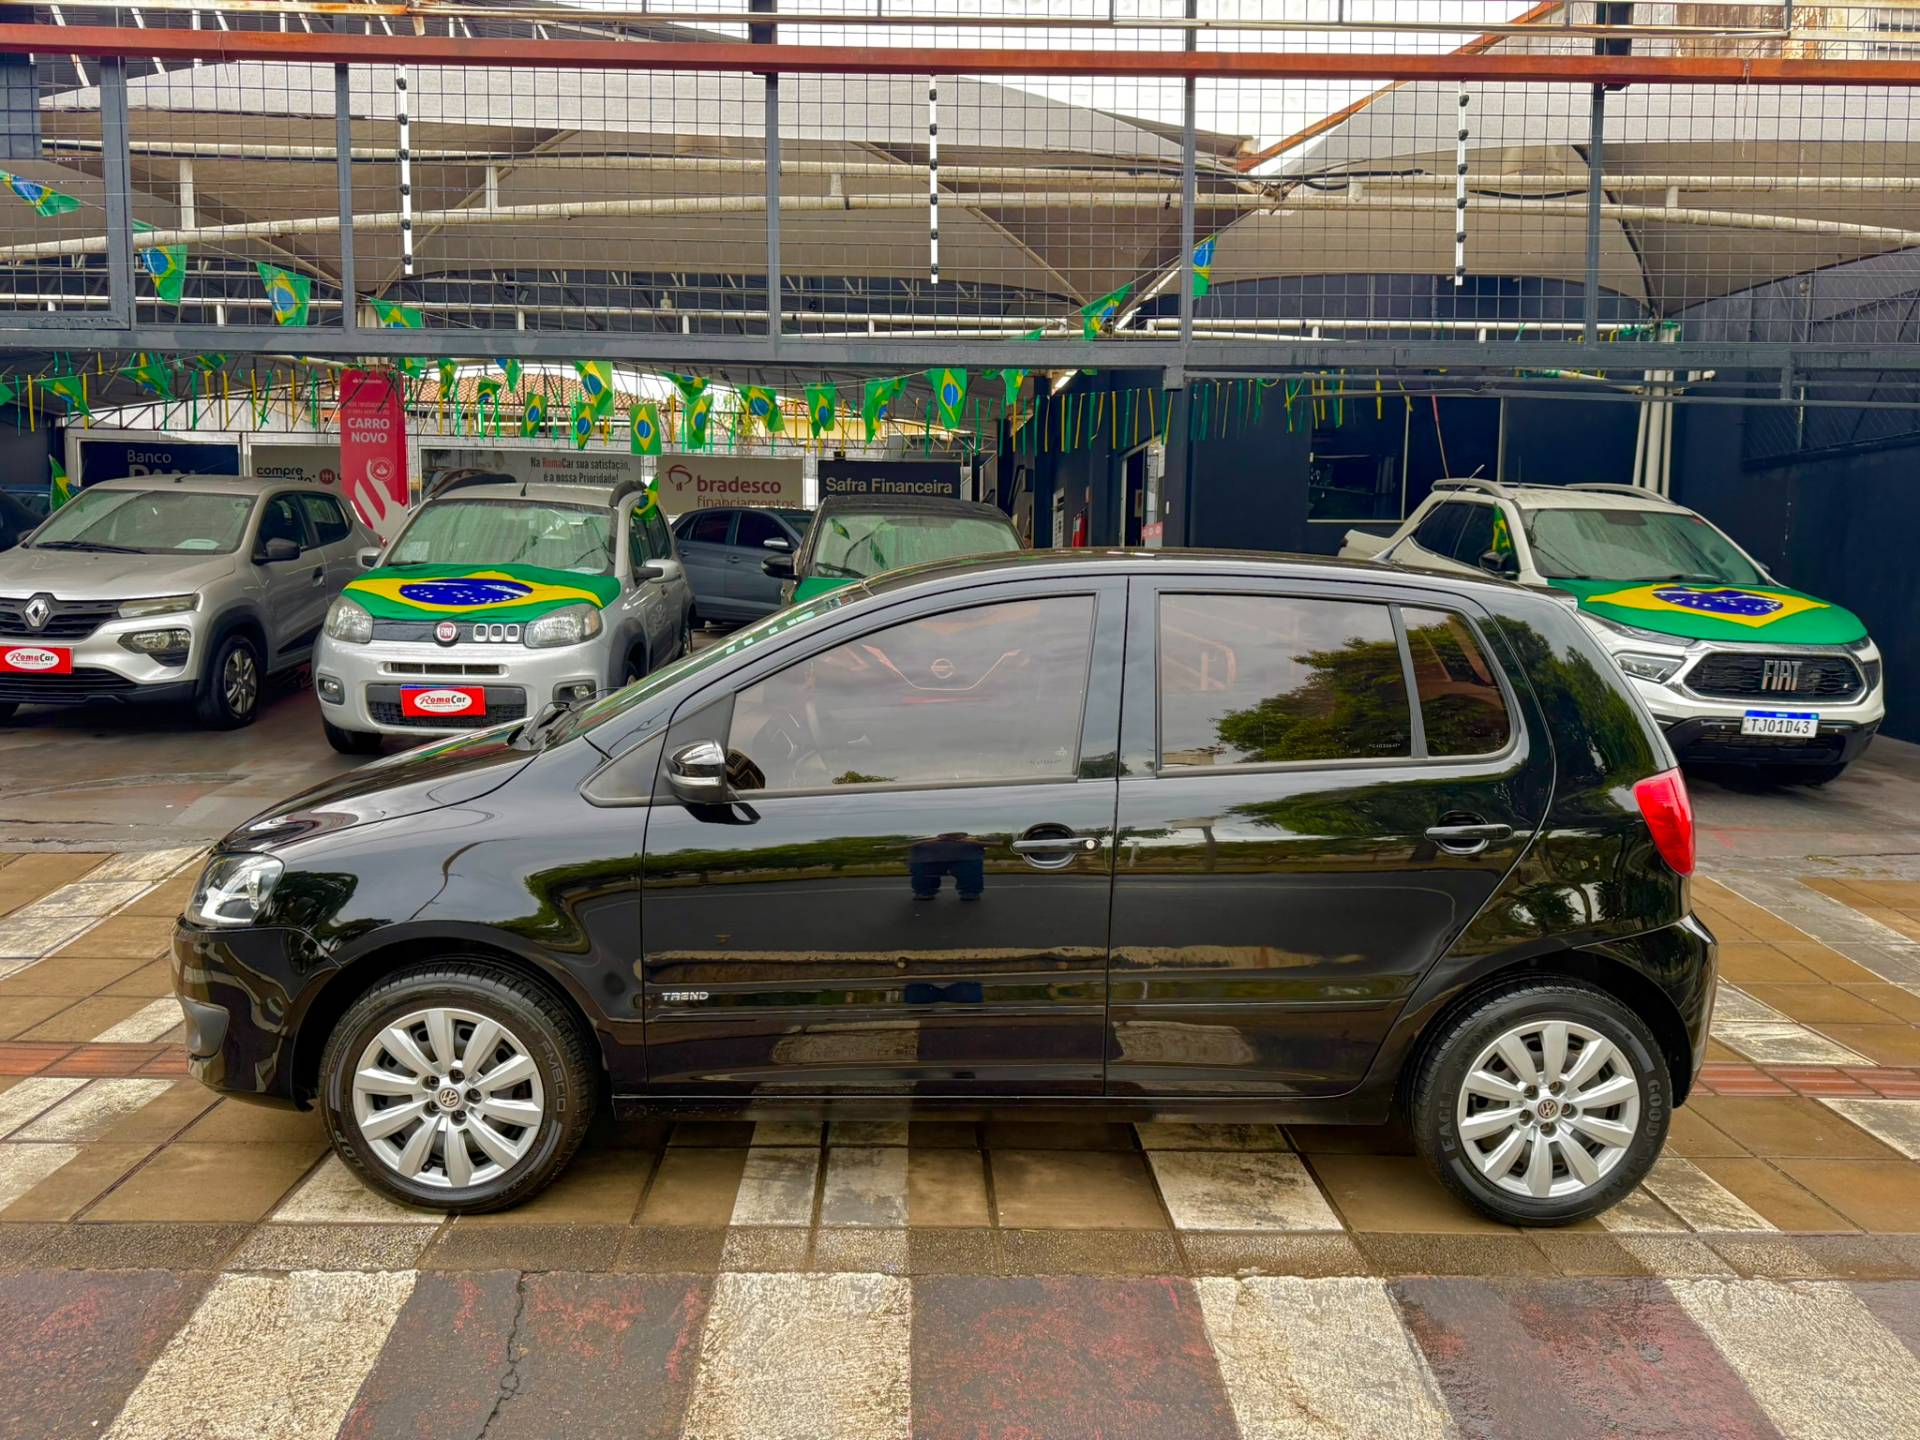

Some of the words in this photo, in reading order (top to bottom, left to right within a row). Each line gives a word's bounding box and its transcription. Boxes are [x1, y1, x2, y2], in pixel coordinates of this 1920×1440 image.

[347, 417, 390, 430] CARRO
[351, 432, 388, 444] NOVO
[127, 449, 172, 465] Banco
[576, 460, 589, 469] sua
[256, 465, 304, 478] compre
[697, 475, 782, 494] bradesco
[826, 477, 867, 492] Safra
[871, 478, 953, 494] Financeira
[10, 651, 55, 663] RomaCar
[1761, 660, 1803, 691] FIAT
[418, 694, 467, 705] RomaCar
[662, 991, 710, 1001] TREND
